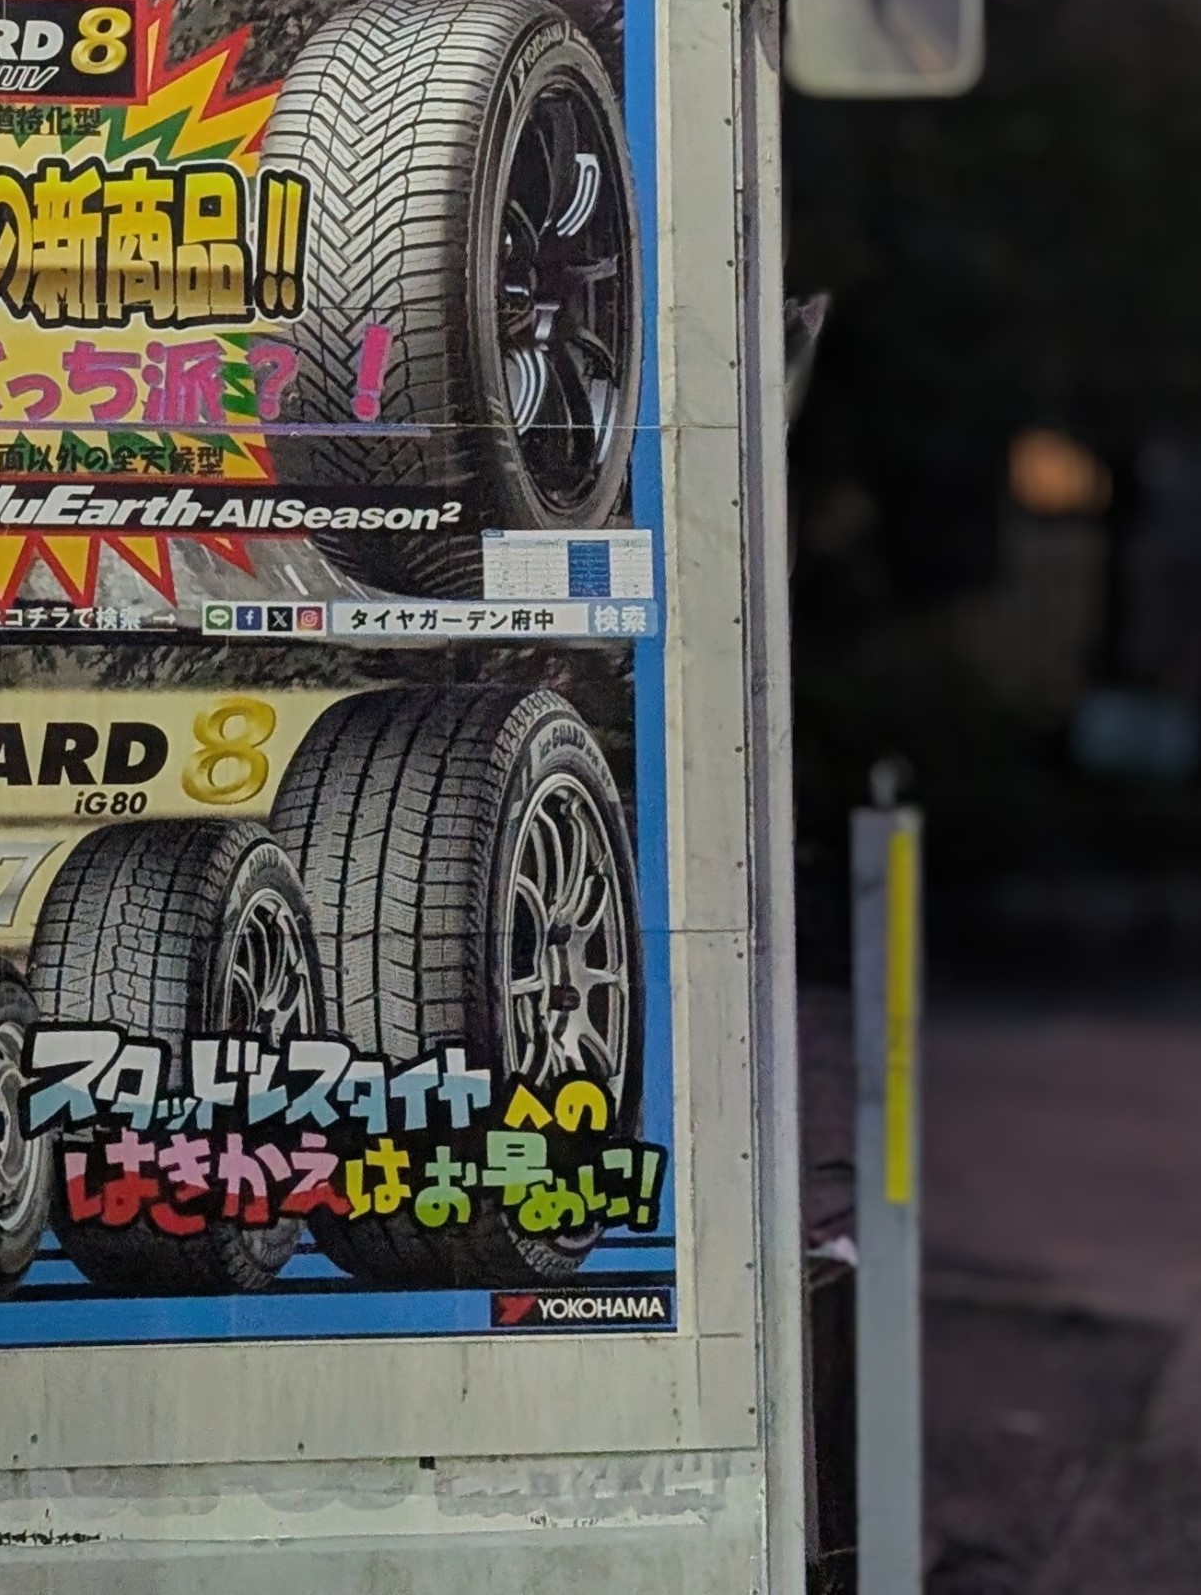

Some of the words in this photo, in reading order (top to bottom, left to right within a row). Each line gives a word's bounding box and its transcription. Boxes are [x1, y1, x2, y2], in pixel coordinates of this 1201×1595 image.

[71, 6, 133, 76] 8
[350, 609, 555, 631] タイヤガーデン府中
[594, 605, 646, 633] 検索
[181, 697, 276, 805] 8
[74, 791, 148, 815] iG80
[538, 1297, 665, 1320] YOKOHAMA
